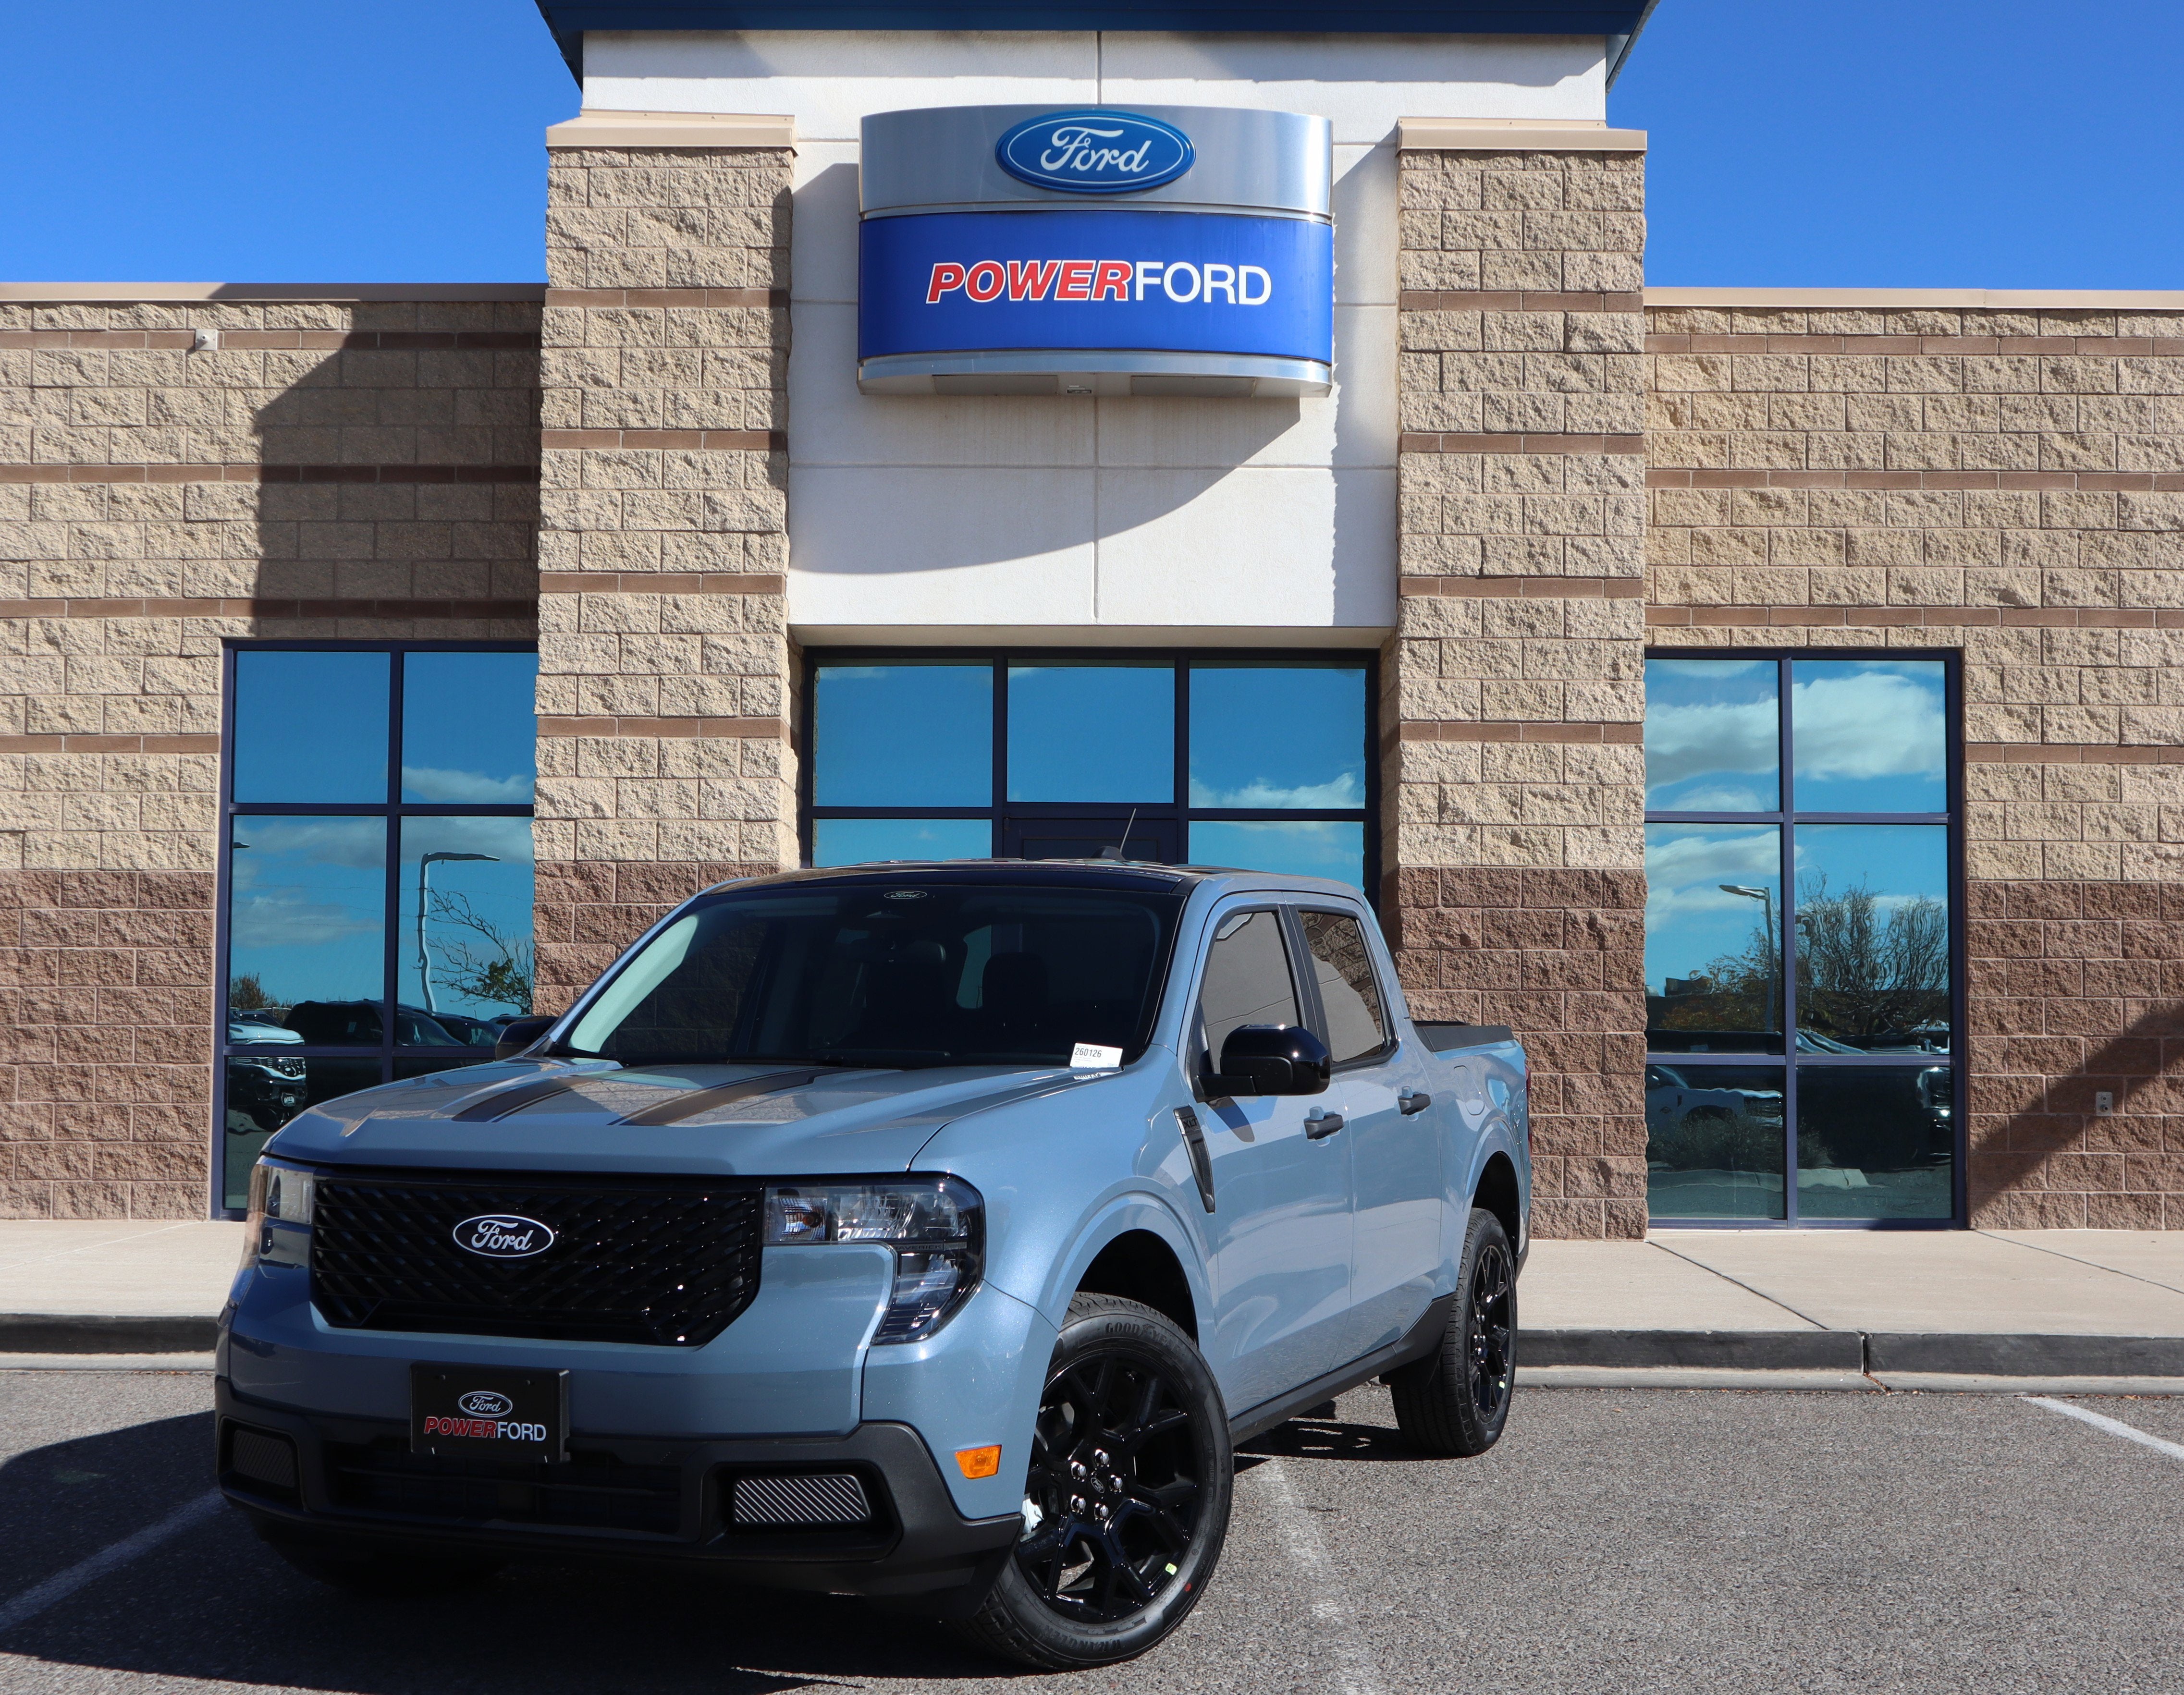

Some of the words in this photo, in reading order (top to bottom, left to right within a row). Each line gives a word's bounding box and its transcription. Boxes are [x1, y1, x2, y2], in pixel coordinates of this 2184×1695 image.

[1040, 125, 1153, 173] Ford
[925, 259, 1272, 305] POWERFORD
[1075, 1047, 1102, 1058] 260126
[1182, 1119, 1198, 1129] XLT
[470, 1219, 534, 1251] Ford
[469, 1395, 501, 1412] Ford
[424, 1416, 547, 1442] POWERFORD
